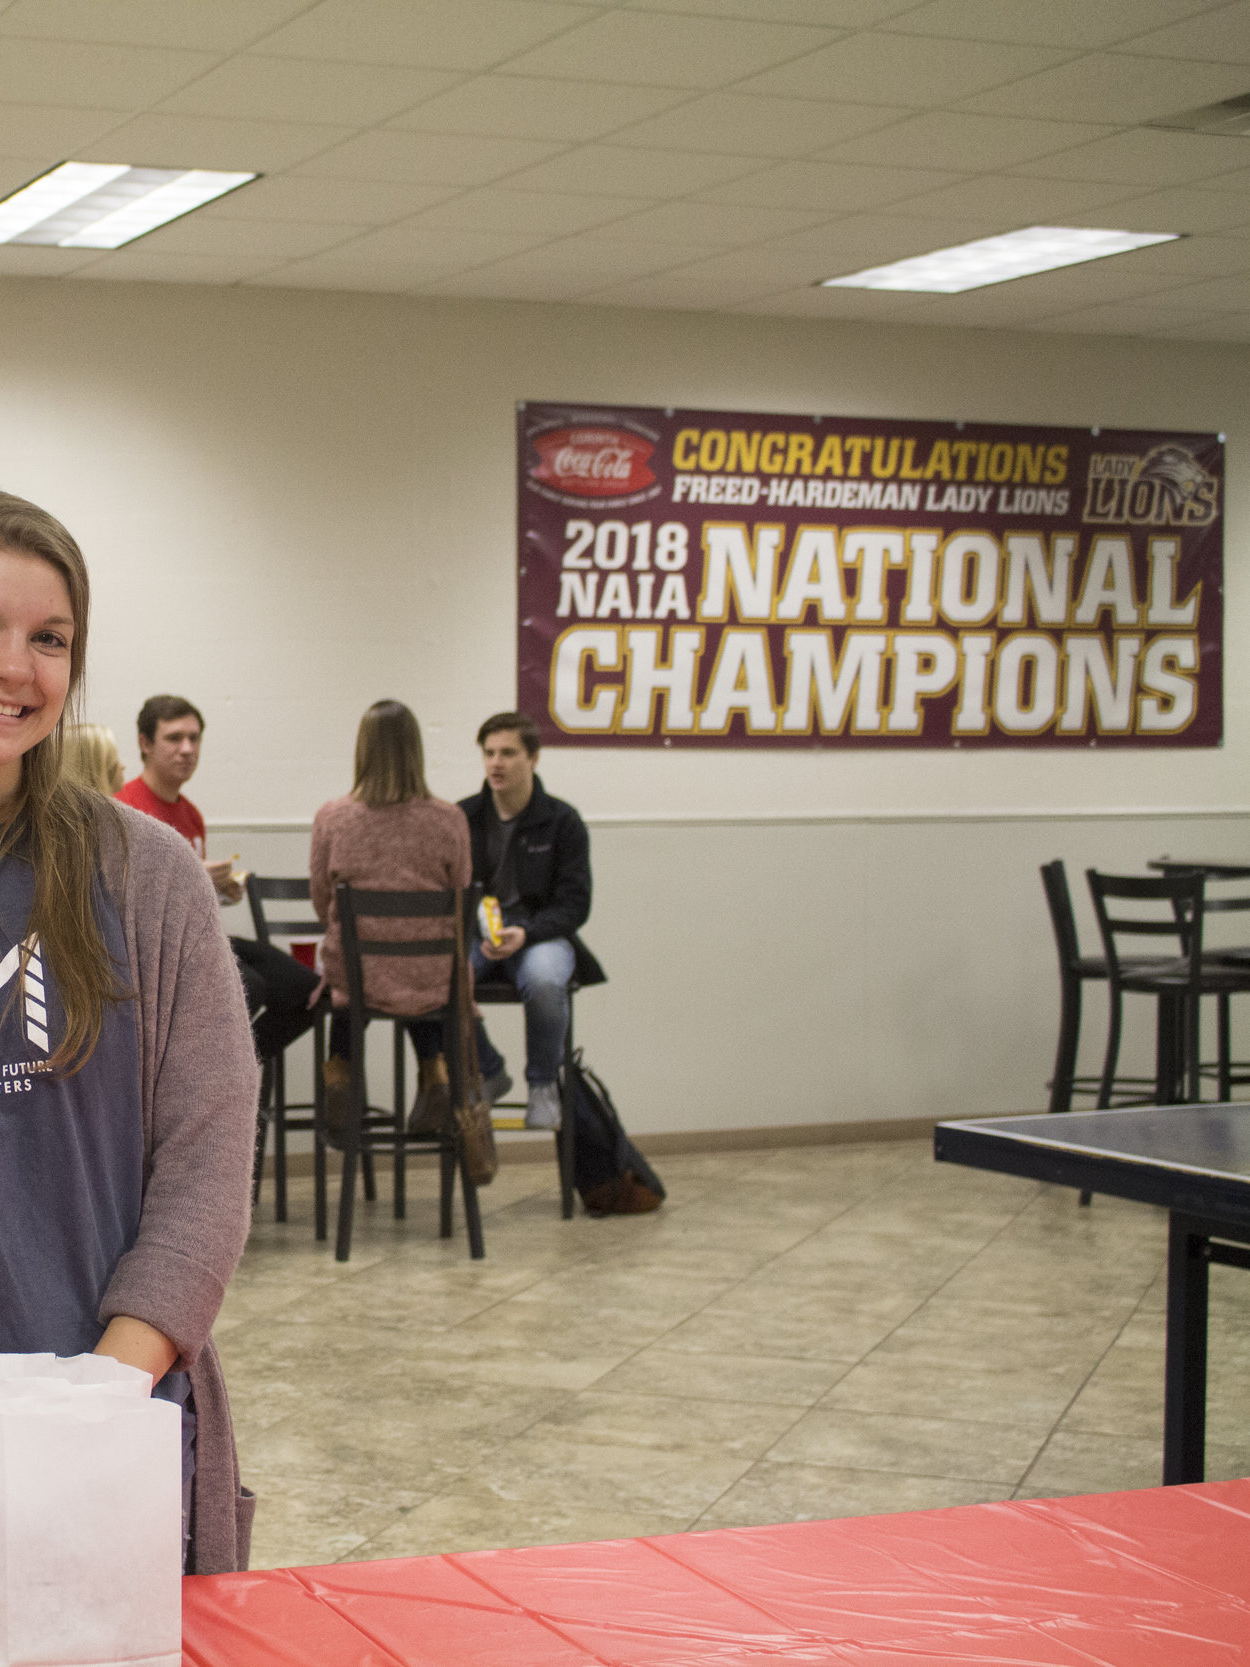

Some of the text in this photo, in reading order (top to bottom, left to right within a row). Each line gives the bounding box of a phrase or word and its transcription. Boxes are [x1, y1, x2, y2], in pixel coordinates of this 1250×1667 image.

[672, 428, 1069, 485] CONGRATULATIONS
[671, 474, 919, 512] FREED-HARDEMAN
[916, 484, 998, 515] LADY
[997, 486, 1071, 516] LIONS
[1083, 477, 1219, 525] LIONS
[562, 519, 689, 571] 2018
[556, 571, 691, 620] NAIA
[697, 521, 1203, 629] NATIONAL
[549, 622, 1200, 737] CHAMPIONS
